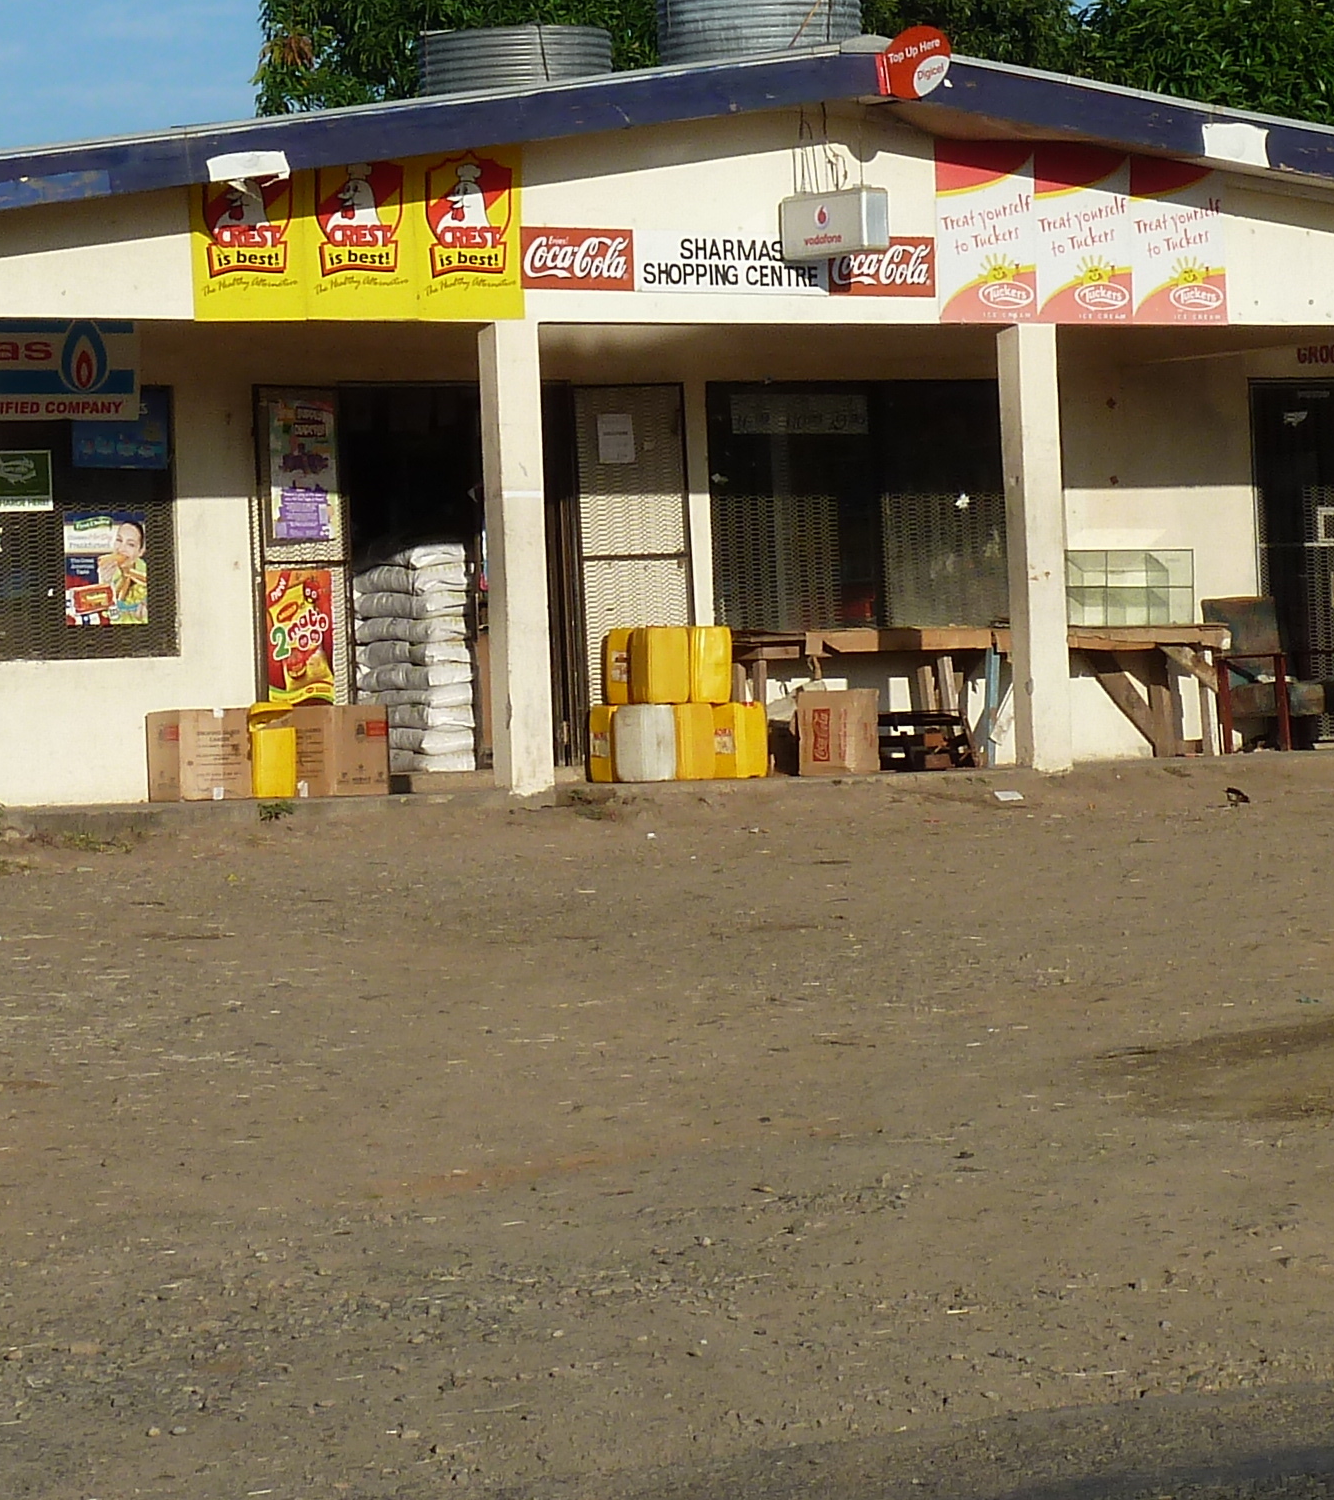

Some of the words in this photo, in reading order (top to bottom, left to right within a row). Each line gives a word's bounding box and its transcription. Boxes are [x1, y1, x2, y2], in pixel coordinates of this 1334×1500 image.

[887, 52, 904, 64] Top
[905, 46, 919, 58] Up
[919, 39, 941, 52] Here
[917, 62, 945, 80] Digicel
[941, 210, 975, 230] Treat
[979, 193, 1031, 230] yourself
[1037, 212, 1072, 233] Treat
[1075, 196, 1127, 232] yourself
[1134, 218, 1167, 234] Treat
[1170, 197, 1221, 234] yourself
[216, 226, 281, 248] CREST
[329, 224, 392, 247] CREST
[439, 226, 501, 248] CREST
[804, 234, 842, 246] vodafone
[955, 239, 969, 255] to
[971, 224, 1019, 248] Tuckers
[1051, 241, 1065, 257] to
[1068, 227, 1115, 250] Tuckers
[1147, 243, 1161, 258] to
[1163, 228, 1209, 252] Tuckers
[217, 254, 231, 267] is
[236, 250, 279, 266] best!
[329, 253, 343, 266] is
[348, 250, 389, 264] best!
[439, 254, 453, 268] is
[457, 252, 498, 266] best!
[523, 236, 630, 278] Coca-Cola
[680, 238, 782, 262] SHARMAS
[643, 263, 739, 286] SHOPPING
[746, 266, 819, 288] CENTRE
[832, 245, 931, 285] Coca-Cola
[202, 285, 216, 297] The
[218, 276, 250, 291] Healthy
[314, 284, 328, 296] The
[330, 276, 361, 290] Healthy
[425, 285, 438, 297] The
[440, 277, 471, 291] Healthy
[984, 284, 1028, 303] Tuckers
[1080, 286, 1123, 303] Tuckers
[1175, 287, 1217, 304] Tuckers
[46, 401, 123, 414] COMPANY
[271, 578, 287, 602] new
